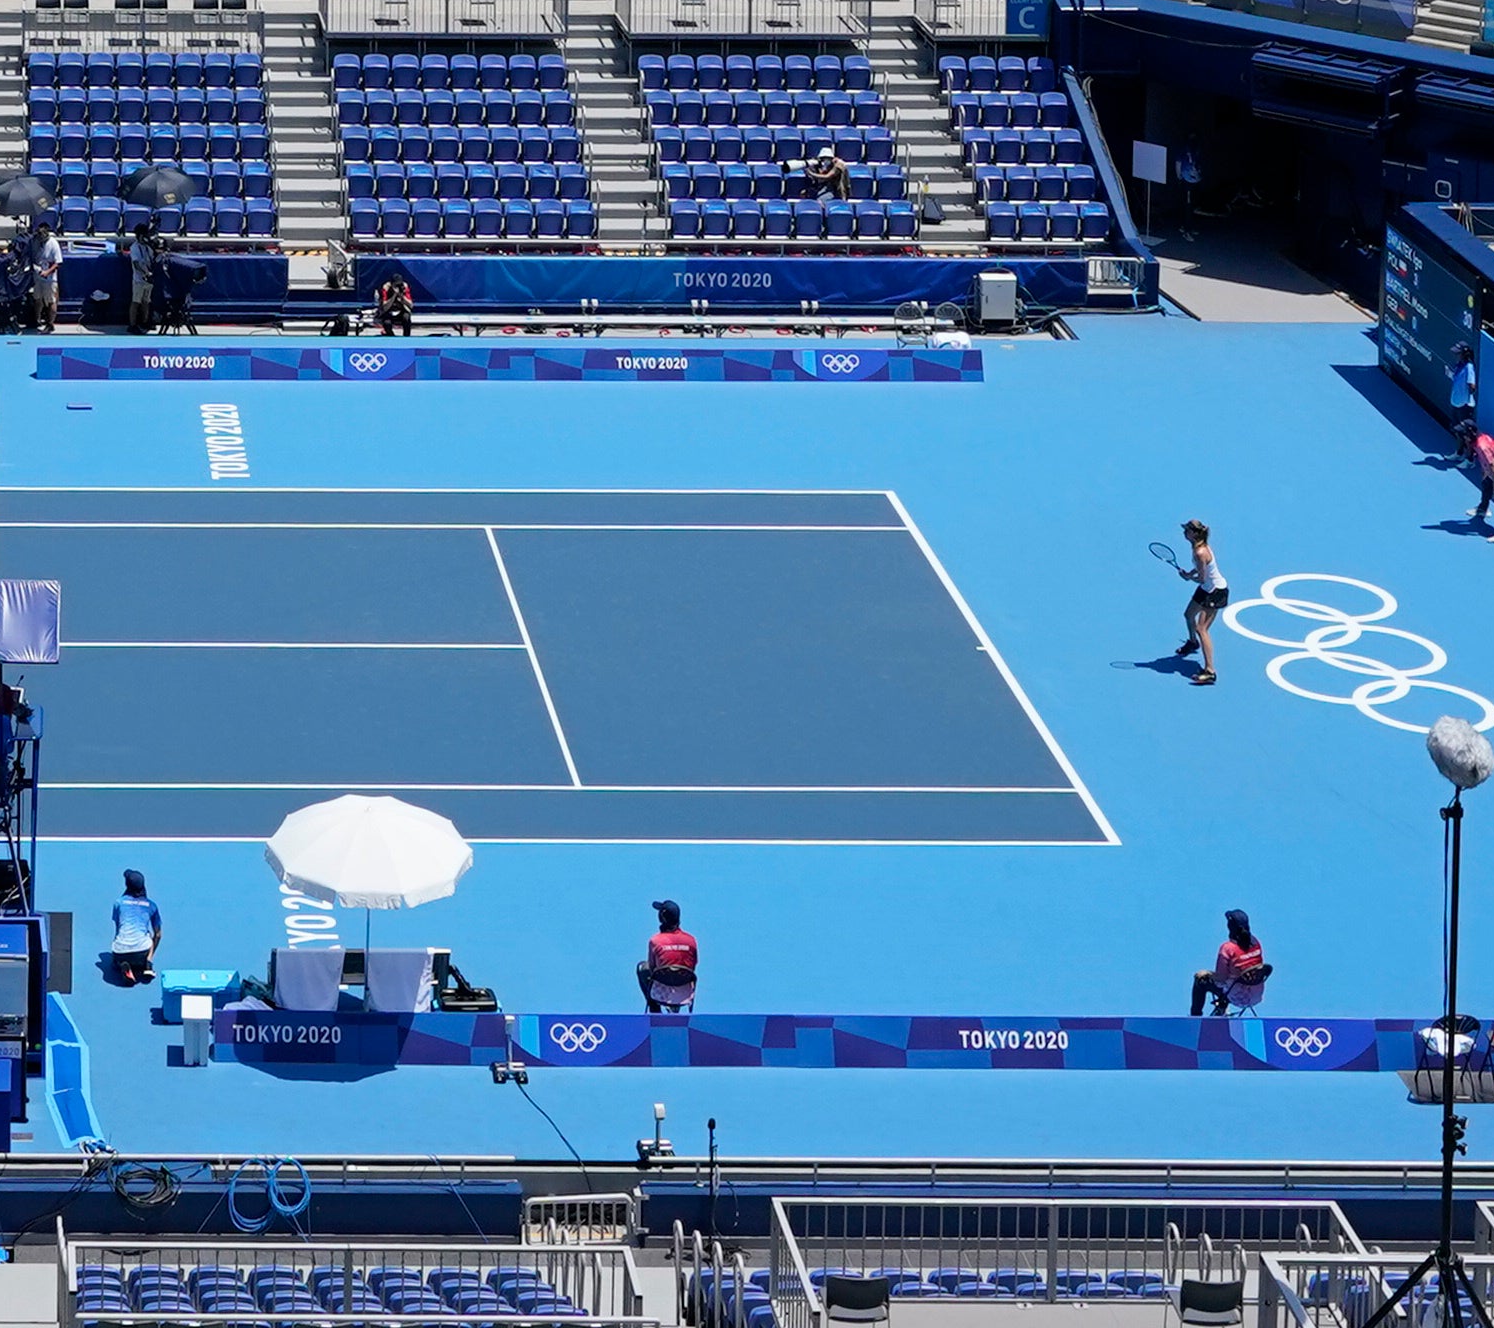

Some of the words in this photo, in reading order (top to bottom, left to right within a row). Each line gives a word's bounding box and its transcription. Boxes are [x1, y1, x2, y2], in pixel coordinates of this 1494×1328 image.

[1019, 7, 1035, 29] C
[674, 273, 725, 288] TOKYO
[732, 273, 771, 288] 2020
[143, 355, 183, 369] TOKYO
[184, 355, 215, 369] 2020
[616, 357, 654, 369] TOKYO
[657, 357, 688, 370] 2020
[200, 403, 239, 437] 2020
[210, 439, 250, 480] TOKYO
[232, 1025, 293, 1044] TOKYO
[298, 1026, 341, 1046] 2020
[959, 1029, 1020, 1049] TOKYO
[1025, 1029, 1069, 1049] 2020
